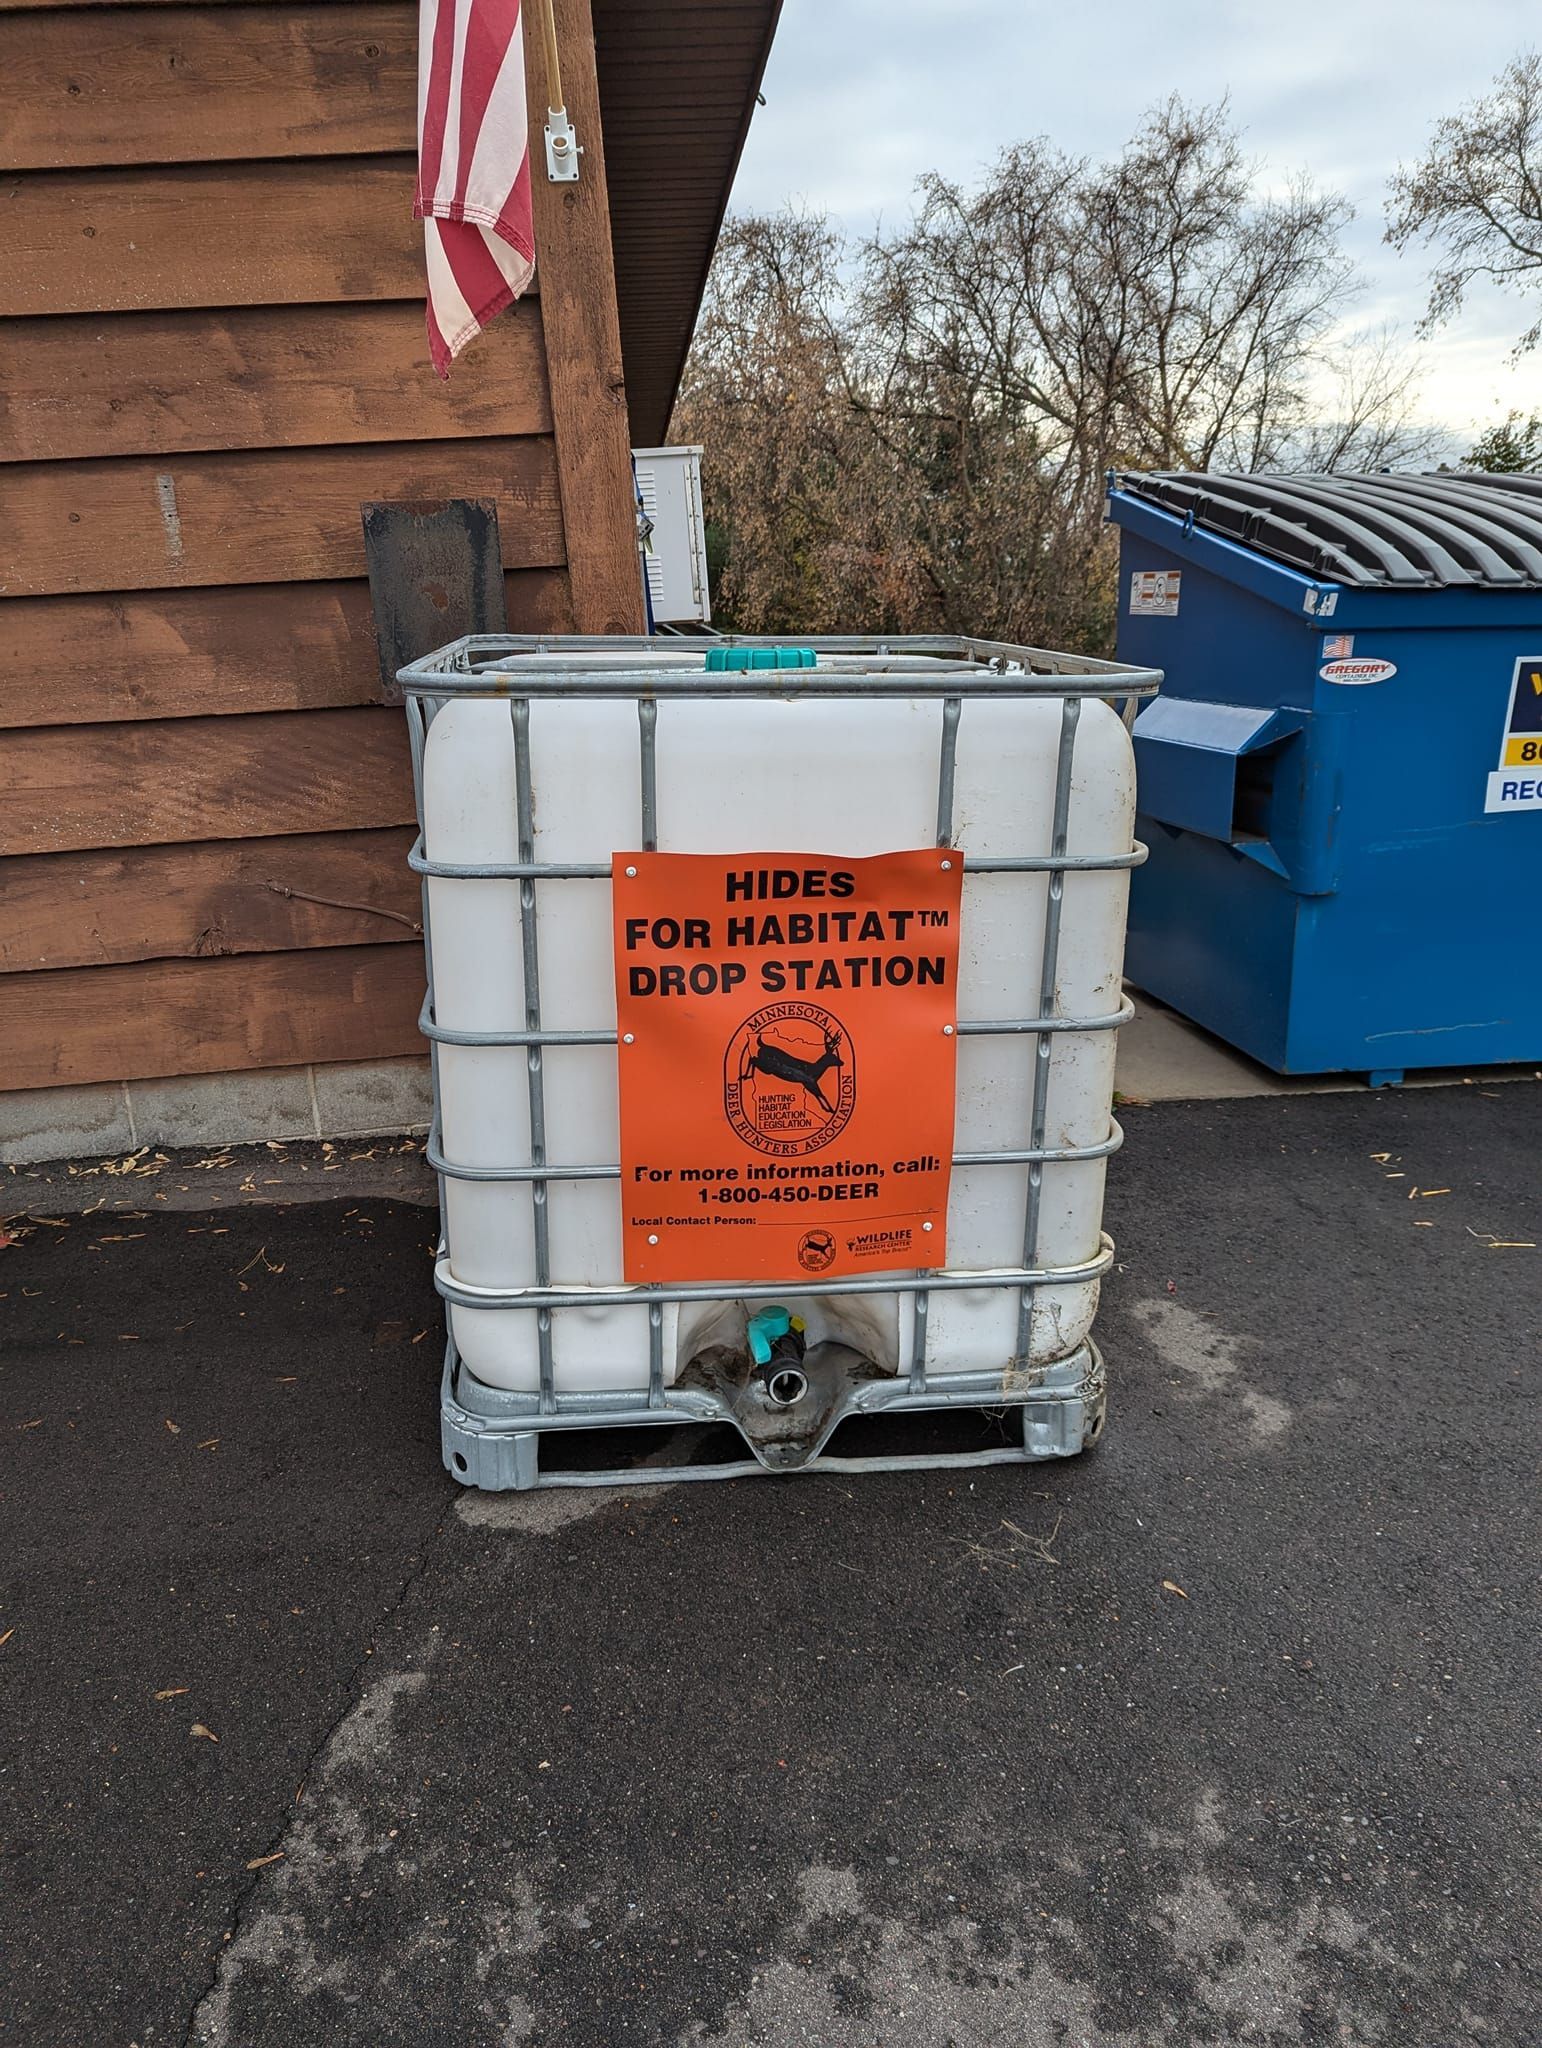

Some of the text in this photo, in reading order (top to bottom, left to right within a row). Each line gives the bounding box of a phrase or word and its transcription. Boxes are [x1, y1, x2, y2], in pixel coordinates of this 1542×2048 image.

[1327, 664, 1390, 674] GREGORY
[726, 870, 856, 902] HIDES
[626, 918, 711, 950] FOR
[629, 957, 946, 997] DROP STATION
[748, 1005, 829, 1031] MINNESOTA
[758, 1094, 796, 1104] HUNTING
[758, 1103, 791, 1112] HABITAT
[728, 1075, 852, 1154] DEER HUNTERS ASSOCIATION
[758, 1111, 806, 1121] EDUCATION
[758, 1119, 812, 1130] LEGISLATION
[634, 1156, 940, 1182] For more information, call:
[698, 1182, 879, 1204] 1-800-450-DEER
[631, 1215, 757, 1226] Local Contact Person:
[856, 1229, 912, 1244] WILDLIFE
